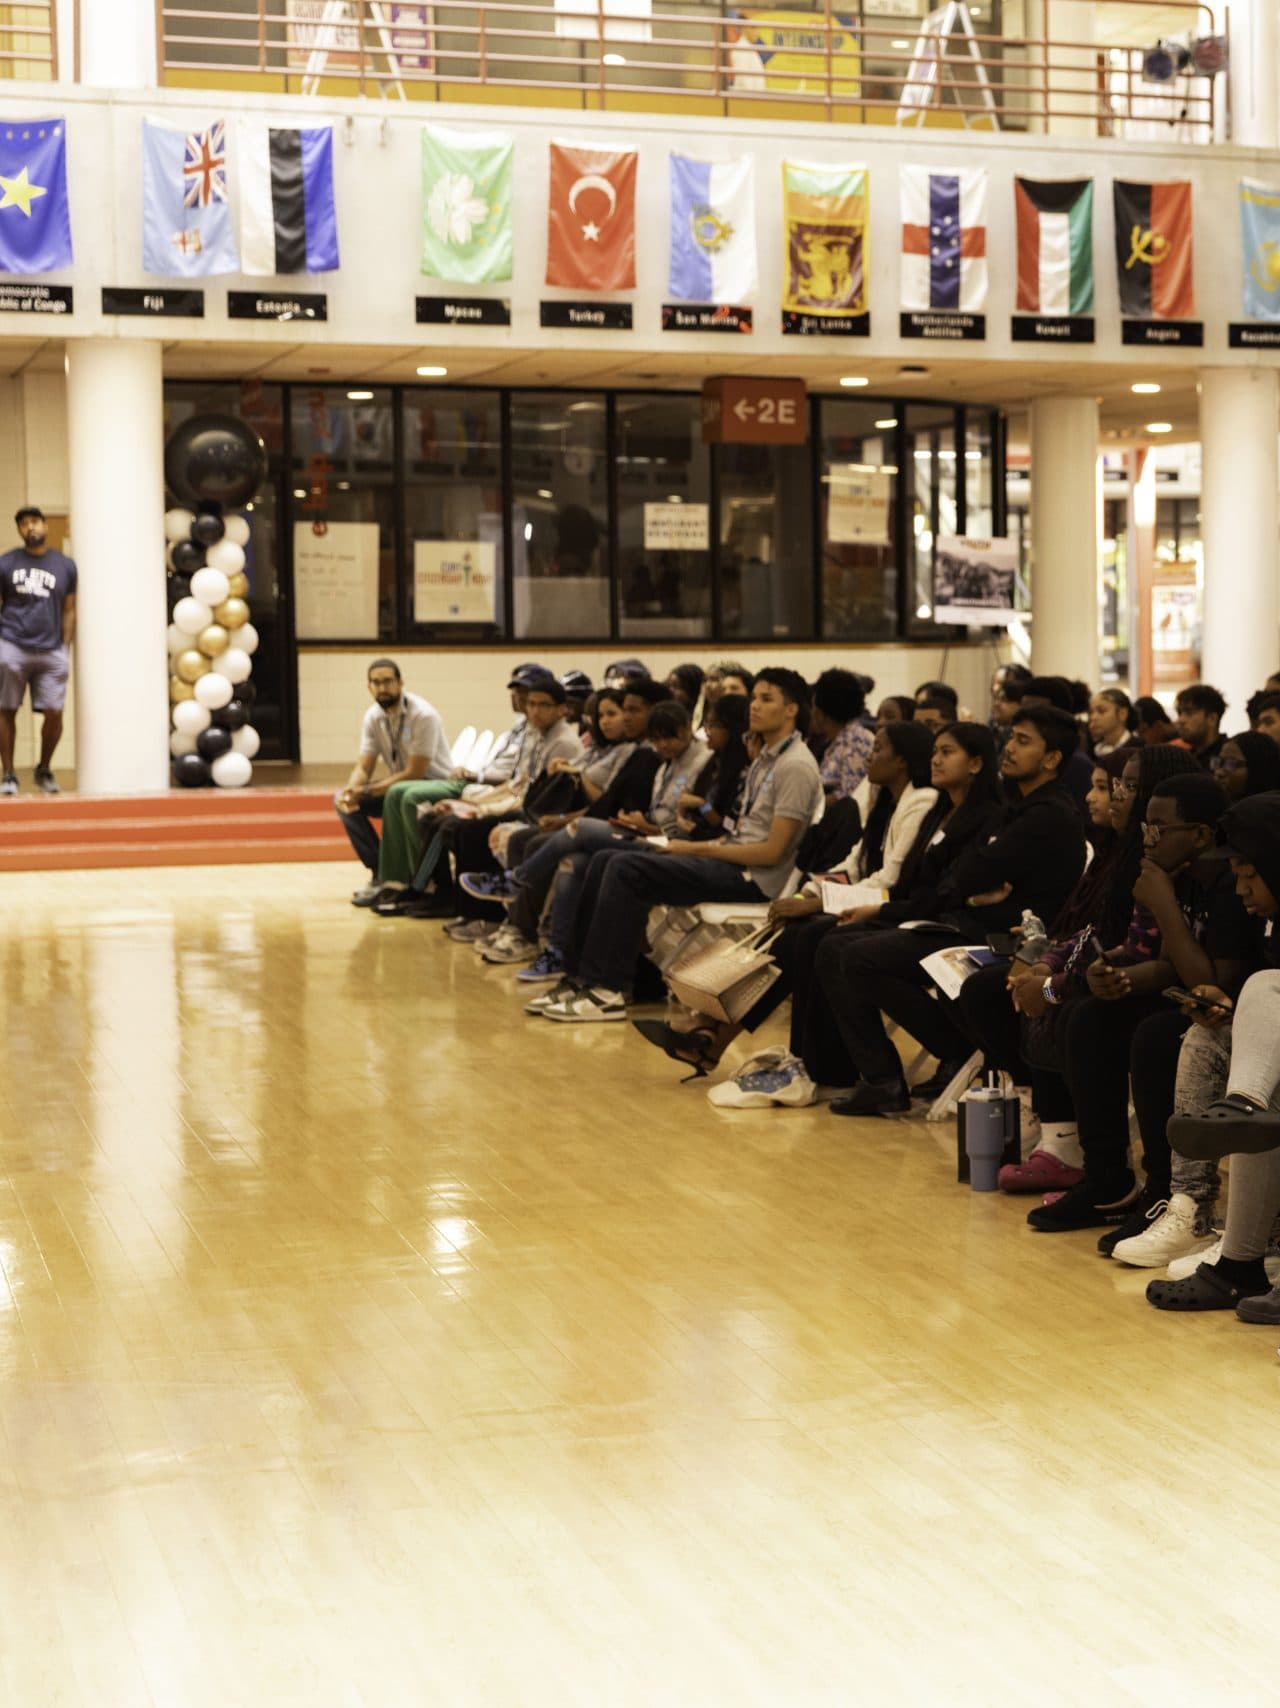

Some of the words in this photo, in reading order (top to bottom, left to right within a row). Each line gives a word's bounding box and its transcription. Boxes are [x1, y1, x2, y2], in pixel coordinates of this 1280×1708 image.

[0, 286, 50, 299] emocratic
[143, 296, 164, 311] Fiji
[256, 299, 301, 314] Estonia
[568, 309, 606, 324] Turkey
[675, 311, 697, 325] San
[820, 317, 852, 330] Lanka
[757, 398, 797, 424] 2E
